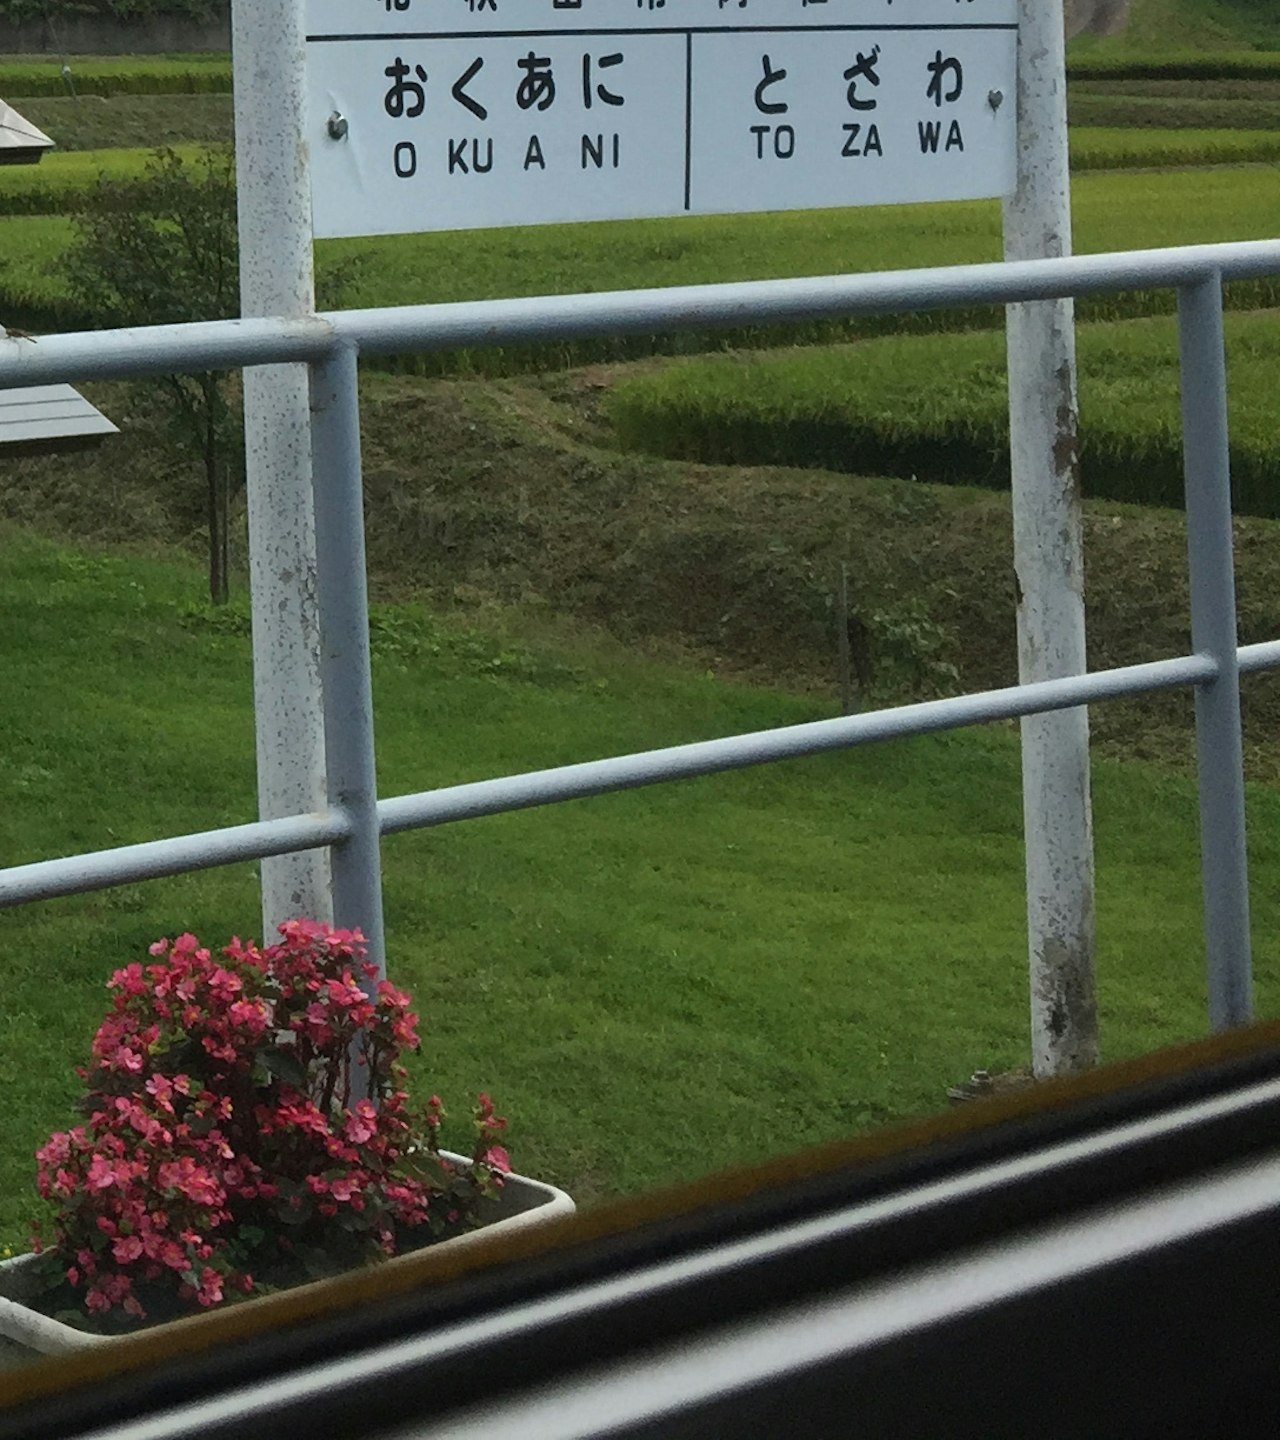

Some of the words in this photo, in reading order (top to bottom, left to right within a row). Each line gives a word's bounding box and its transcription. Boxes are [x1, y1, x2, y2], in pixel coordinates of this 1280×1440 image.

[384, 51, 625, 121] おくあに
[754, 45, 963, 115] とざわ
[393, 141, 417, 179] O
[448, 138, 493, 174] KU
[523, 134, 546, 170] A
[581, 133, 619, 169] NI
[749, 124, 795, 159] TO
[841, 123, 883, 158] ZA
[917, 119, 964, 154] WA
